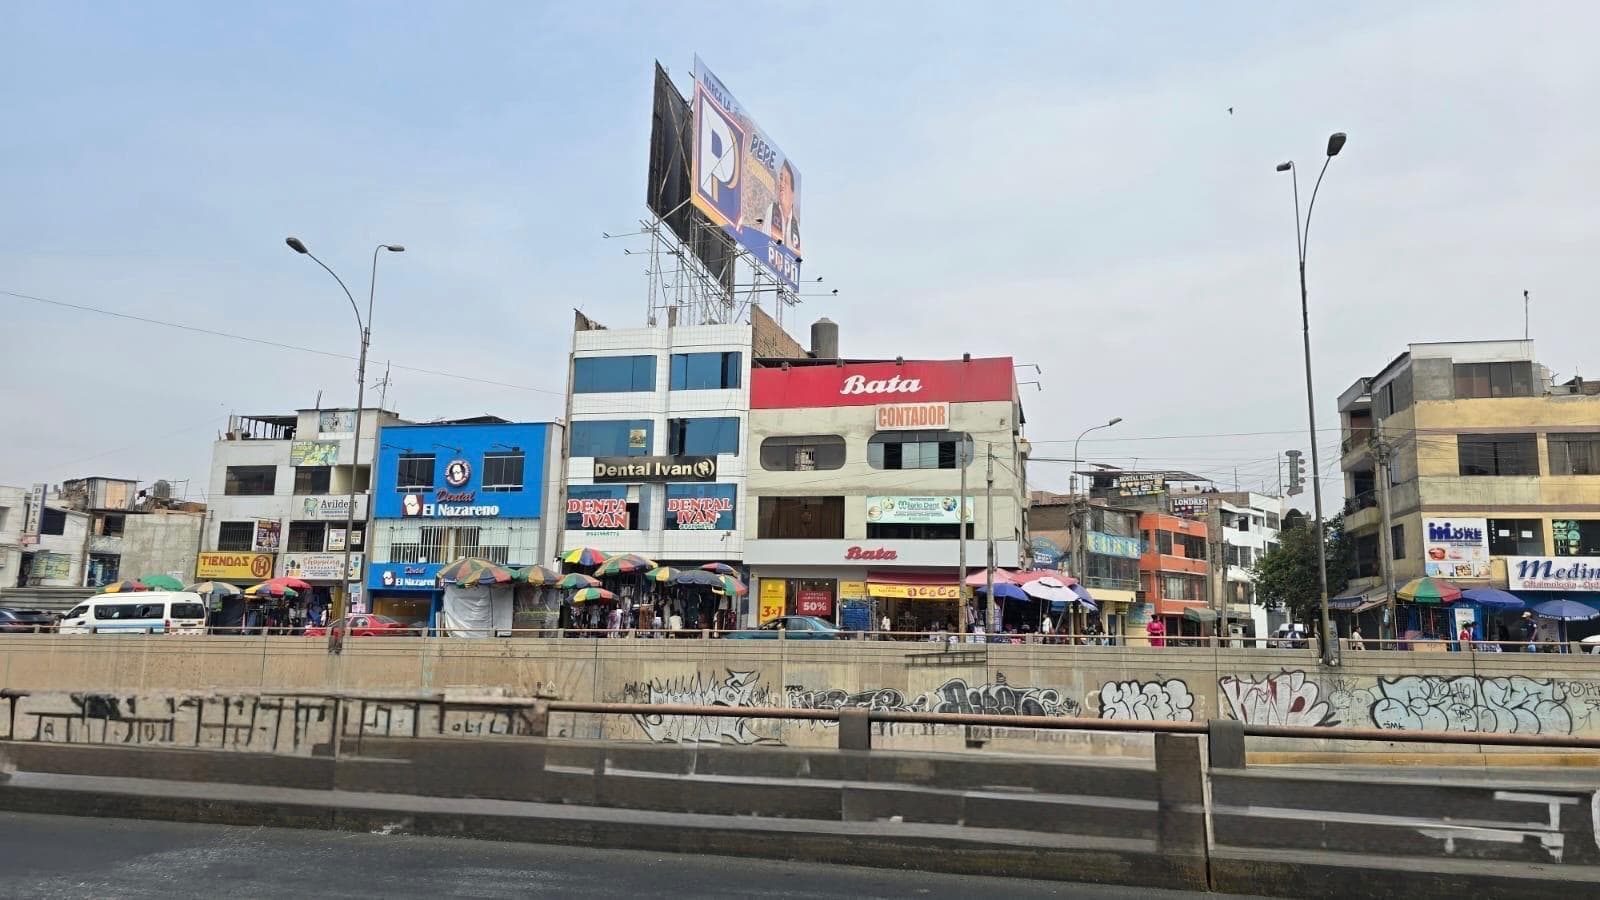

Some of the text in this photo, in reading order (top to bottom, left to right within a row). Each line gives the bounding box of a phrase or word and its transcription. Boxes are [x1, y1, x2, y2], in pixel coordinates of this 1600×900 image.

[750, 133, 777, 170] PEPE
[840, 374, 923, 395] Bata
[878, 405, 946, 427] CONTADOR
[595, 463, 692, 477] Dental Ivan
[436, 488, 476, 503] Dental
[32, 486, 43, 531] DENTAL
[320, 499, 359, 509] Avildet
[423, 503, 500, 517] El Nazareno
[667, 499, 733, 511] DENTAL
[581, 512, 628, 528] IVAN
[676, 510, 718, 525] IVAN
[844, 546, 898, 560] Bata
[201, 555, 250, 567] TIENDAS
[395, 578, 403, 586] El
[803, 601, 827, 611] 50%
